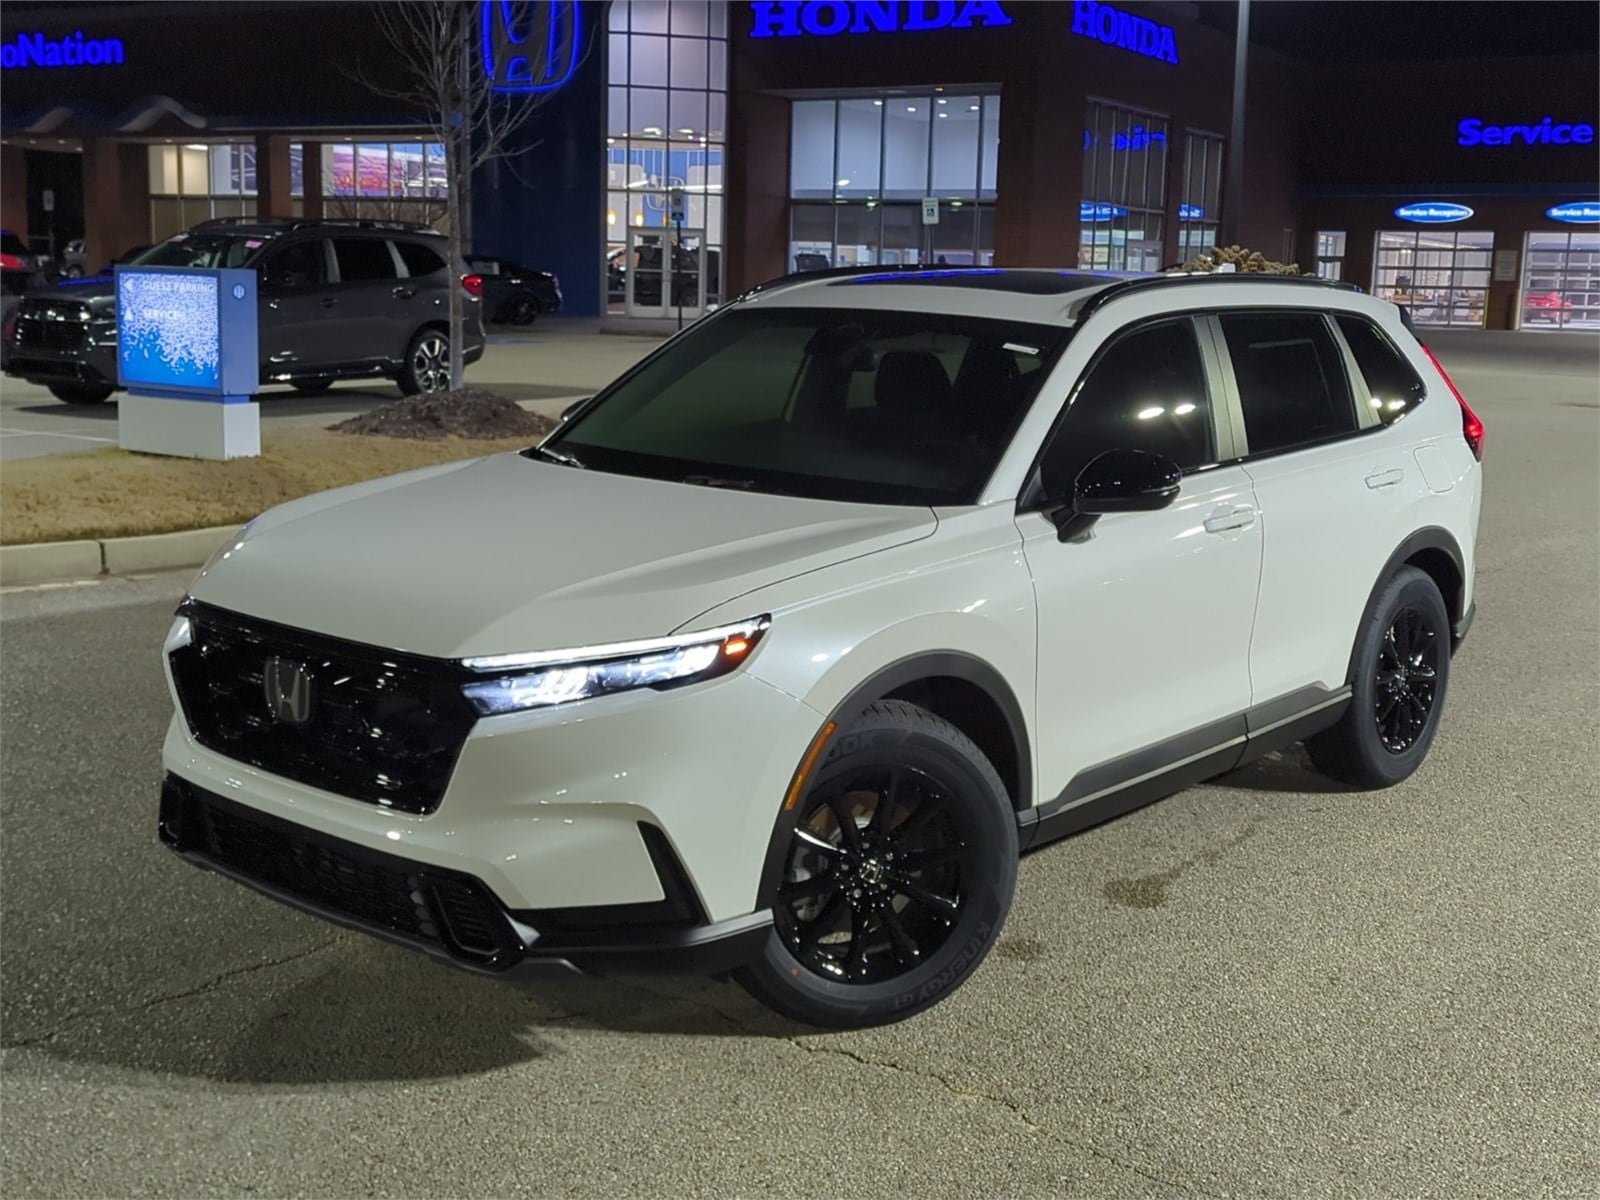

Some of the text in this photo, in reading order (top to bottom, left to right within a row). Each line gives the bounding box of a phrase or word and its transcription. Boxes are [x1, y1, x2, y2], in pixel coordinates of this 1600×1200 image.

[749, 0, 1013, 38] HONDA
[1070, 0, 1179, 64] HONDA
[0, 30, 124, 69] oNation
[1457, 116, 1595, 147] Service
[1399, 208, 1468, 219] Service Reception
[1551, 208, 1582, 217] Service
[142, 280, 216, 293] GUEST PARKING
